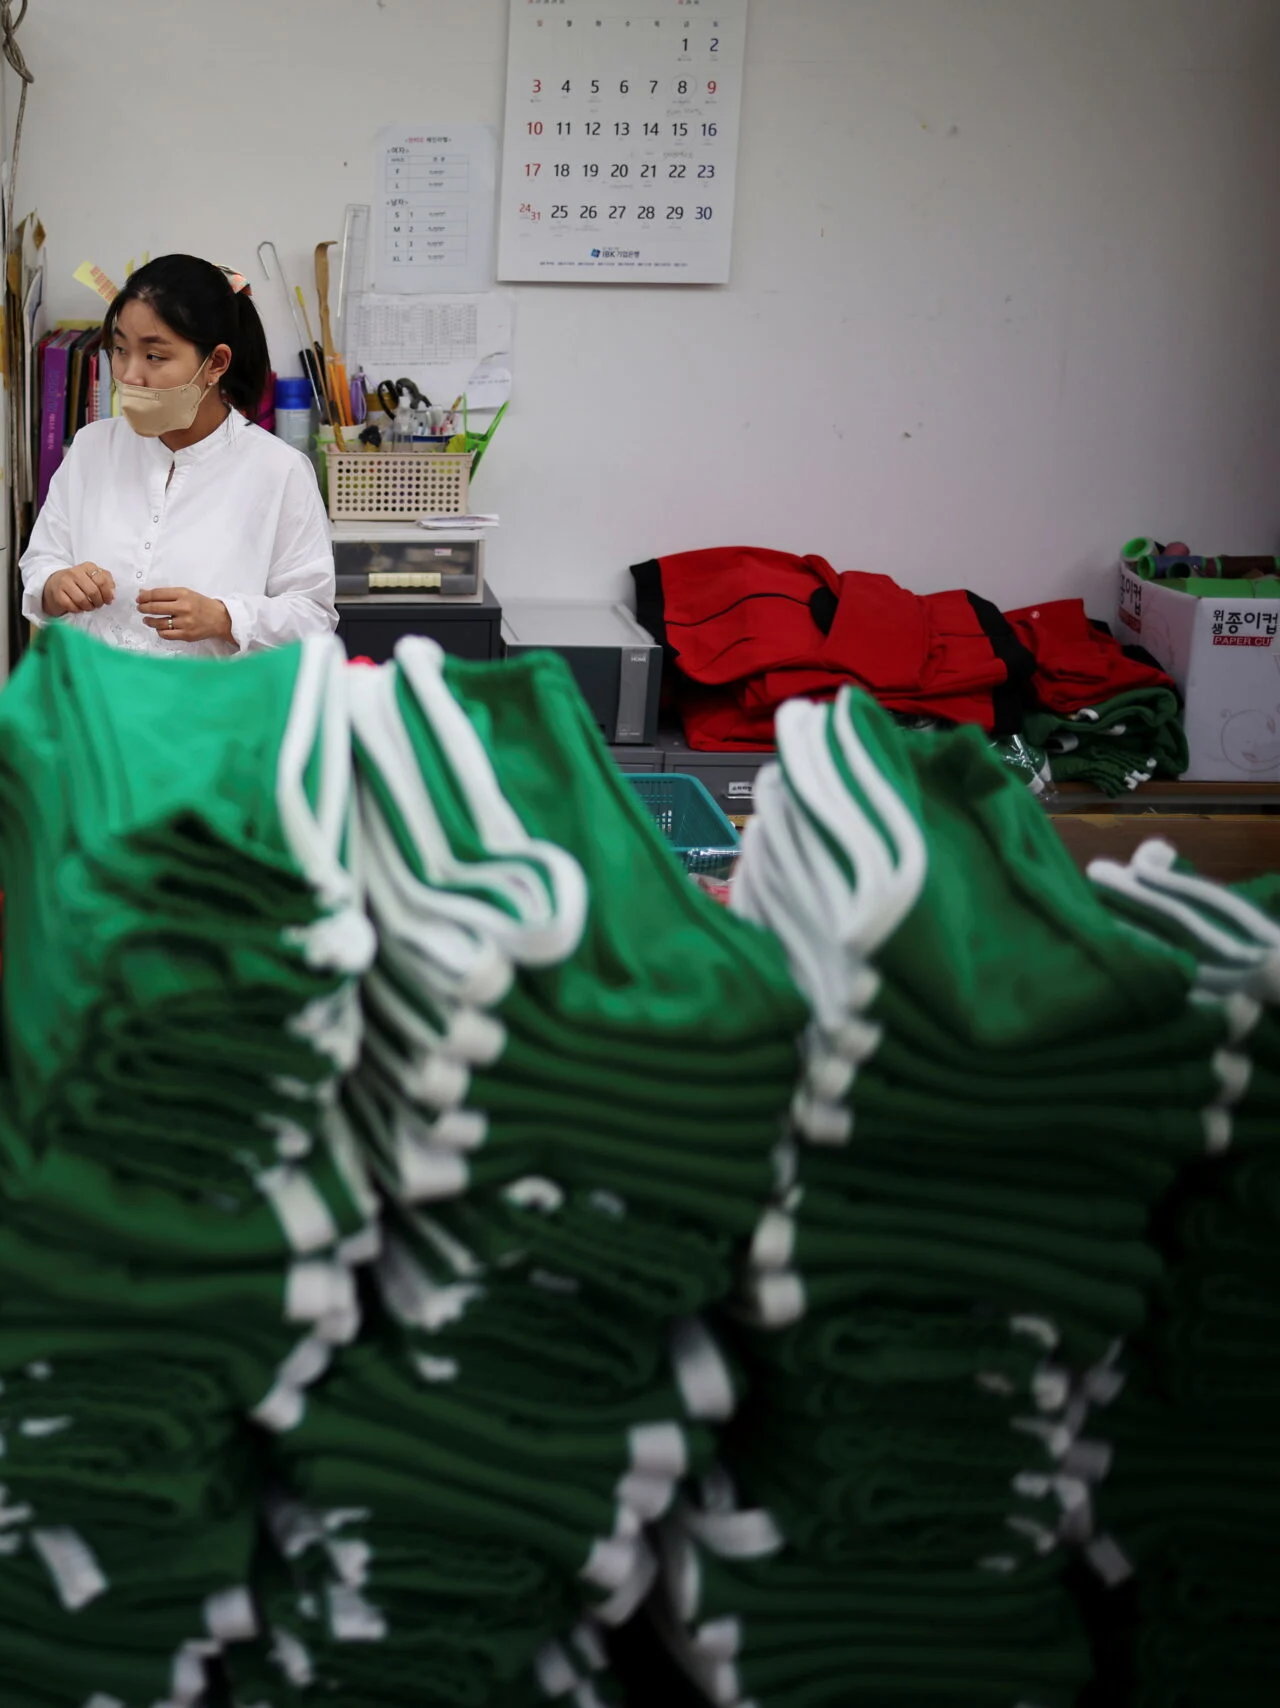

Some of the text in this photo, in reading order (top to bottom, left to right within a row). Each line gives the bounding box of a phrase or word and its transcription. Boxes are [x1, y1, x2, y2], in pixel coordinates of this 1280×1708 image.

[682, 38, 719, 53] 1 2
[532, 79, 717, 95] 3 4 5 6 7 8 9
[527, 121, 718, 137] 10 11 12 13 14 15 16
[524, 163, 715, 179] 17 18 19 20 21 22 23
[519, 203, 713, 221] 24 31 25 26 27 28 29 30
[1225, 611, 1279, 635] 종이컵
[1214, 637, 1273, 646] PAPER CU
